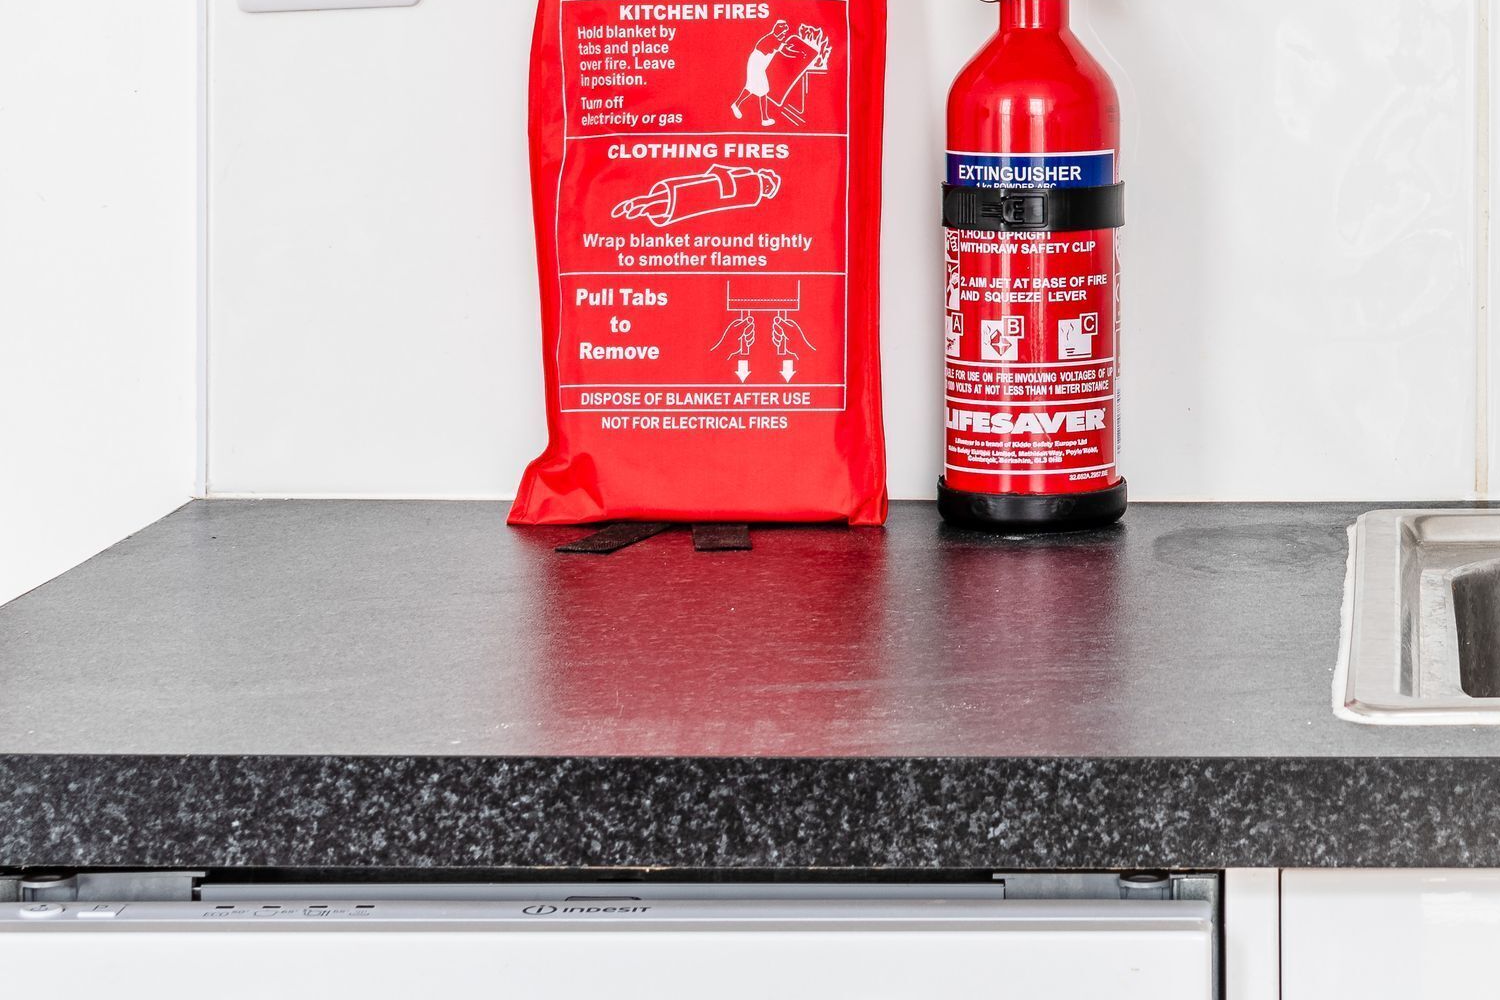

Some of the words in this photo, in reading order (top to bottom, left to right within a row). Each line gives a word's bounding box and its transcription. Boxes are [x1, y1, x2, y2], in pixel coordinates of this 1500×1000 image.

[619, 3, 708, 21] KITCHEN
[713, 2, 770, 20] FIRES
[577, 25, 604, 40] Hold
[605, 24, 657, 39] blanket
[659, 24, 677, 42] by
[577, 41, 602, 56] tabs
[603, 40, 629, 55] and
[631, 40, 669, 57] place
[579, 60, 603, 71] over
[604, 56, 631, 70] fire.
[634, 56, 676, 70] Leave
[580, 73, 590, 87] in
[591, 72, 647, 90] position.
[580, 96, 603, 110] Turn
[605, 95, 624, 109] off
[581, 111, 639, 127] electricity
[641, 114, 657, 124] or
[658, 113, 683, 127] gas
[607, 143, 718, 160] CLOTHING
[724, 143, 790, 159] FIRES
[958, 164, 1082, 182] EXTINGUISHER
[582, 233, 626, 251] Wrap
[629, 232, 691, 248] blanket
[693, 233, 754, 248] around
[757, 233, 813, 252] tightly
[998, 231, 1051, 240] UPRIGHT
[960, 242, 1018, 254] WITHDRAW
[1021, 242, 1069, 254] SAFETY
[1072, 241, 1096, 252] CLIP
[617, 252, 635, 267] to
[638, 251, 708, 267] smother
[710, 251, 768, 267] flames
[961, 277, 967, 287] 2.
[969, 278, 986, 288] AIM
[989, 278, 1011, 288] JET
[1013, 277, 1029, 288] AT
[1033, 276, 1067, 288] BASE
[1069, 276, 1085, 287] OF
[1087, 274, 1108, 285] FIRE
[575, 288, 614, 306] Pull
[618, 287, 668, 306] Tabs
[961, 290, 980, 301] AND
[985, 291, 1041, 303] SQUEEZE
[1048, 290, 1087, 302] LEVER
[609, 315, 632, 333] to
[953, 317, 961, 331] A
[1008, 320, 1020, 334] B
[1083, 315, 1095, 331] C
[579, 341, 660, 360] Remove
[956, 369, 966, 380] FOR
[968, 371, 980, 382] USE
[983, 373, 993, 383] ON
[996, 373, 1014, 383] FIRE
[1015, 373, 1057, 383] INVOLVING
[1060, 370, 1096, 381] VOLTAGES
[1098, 368, 1106, 379] OF
[1107, 367, 1113, 377] UP
[956, 382, 972, 393] VOLTS
[974, 384, 982, 394] AT
[985, 385, 1000, 395] NOT
[1004, 385, 1023, 395] LESS
[1025, 385, 1047, 395] THAN
[1049, 385, 1053, 394] 1
[1055, 383, 1080, 394] METER
[1082, 380, 1109, 392] DISTANCE
[580, 391, 641, 406] DISPOSE
[643, 392, 663, 406] OF
[665, 392, 732, 406] BLANKET
[732, 391, 780, 406] AFTER
[782, 391, 811, 406] USE
[601, 416, 630, 430] NOT
[632, 415, 660, 430] FOR
[662, 415, 747, 430] ELECTRICAL
[748, 415, 788, 430] FIRES
[946, 408, 1106, 434] LIFESAVER
